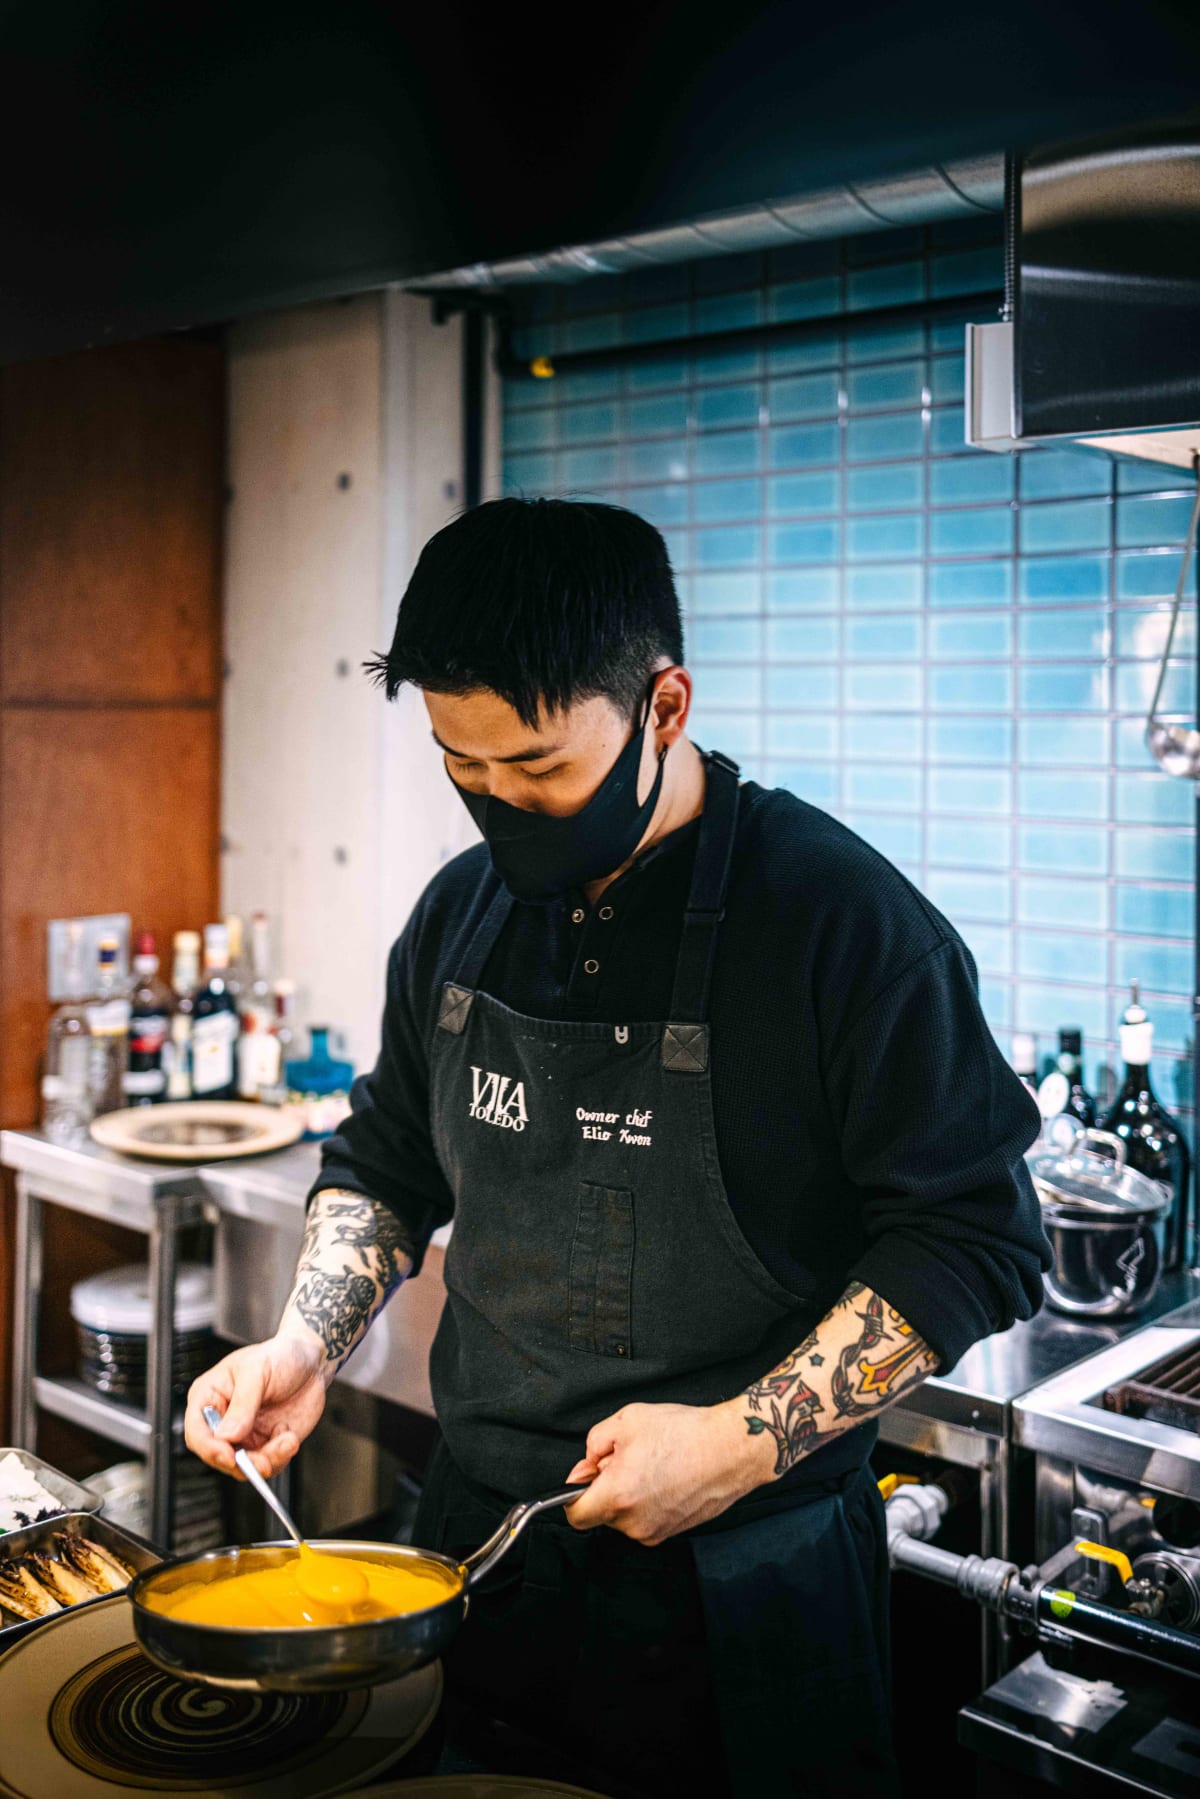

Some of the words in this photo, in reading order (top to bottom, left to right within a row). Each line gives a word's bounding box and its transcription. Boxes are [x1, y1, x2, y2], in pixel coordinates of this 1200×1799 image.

[469, 1066, 530, 1122] VIA
[468, 1102, 526, 1133] TOLEDO
[575, 1107, 620, 1125] Owner
[581, 1126, 613, 1141] Elio
